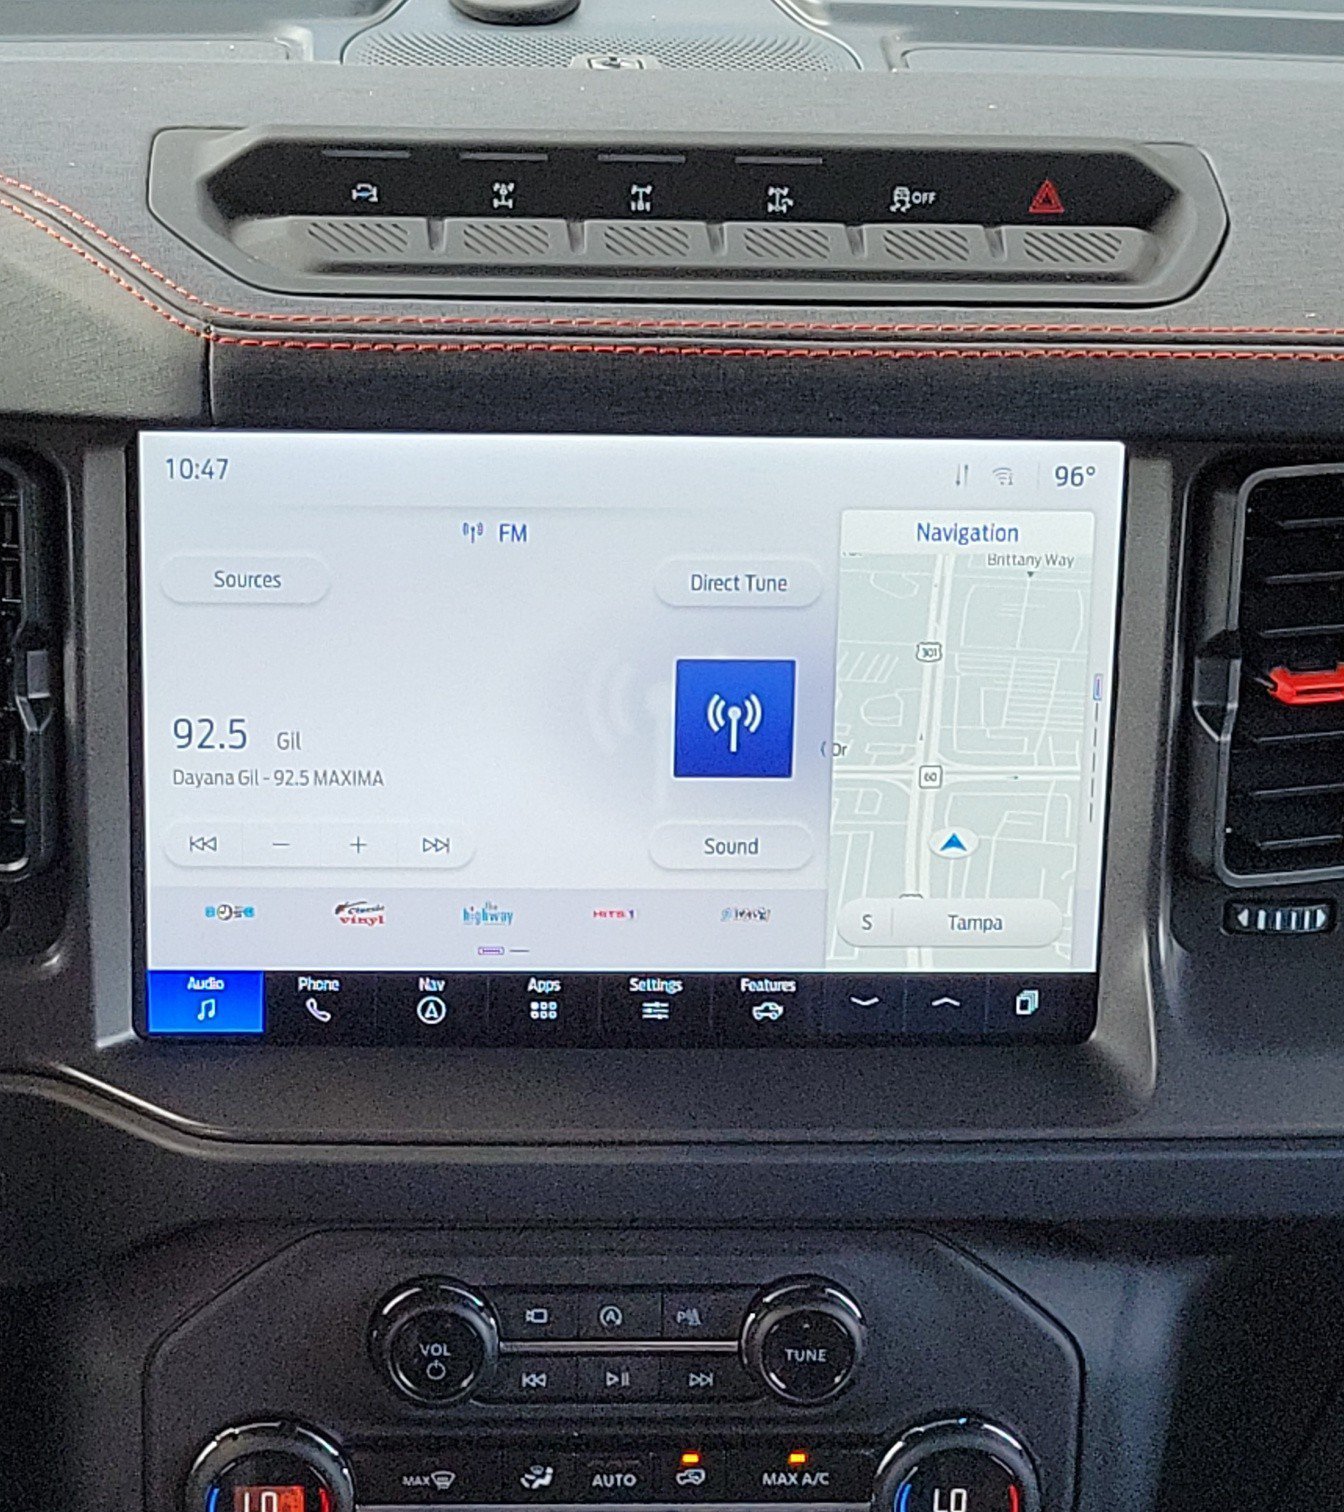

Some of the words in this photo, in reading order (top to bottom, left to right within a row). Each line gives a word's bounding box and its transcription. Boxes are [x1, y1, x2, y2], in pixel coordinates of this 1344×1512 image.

[912, 191, 936, 205] OFF
[165, 457, 230, 480] 10:47
[1055, 465, 1097, 487] 96°
[499, 523, 529, 544] FM
[916, 522, 1019, 546] Navigation
[987, 553, 1041, 568] Brittany
[1045, 553, 1074, 568] Way
[213, 569, 282, 590] Sources
[690, 573, 741, 592] Direct
[746, 573, 788, 592] Tune
[172, 718, 248, 752] 92.5
[276, 731, 302, 752] Gil
[172, 768, 235, 788] Dayana
[237, 768, 260, 787] Gil
[273, 769, 310, 787] 92.5
[313, 769, 385, 787] MAXIMA
[704, 837, 759, 856] Sound
[861, 914, 873, 932] S
[948, 914, 1003, 935] Tampa
[186, 976, 225, 992] Audio
[297, 976, 341, 992] Phone
[418, 977, 446, 992] Nav
[527, 978, 562, 995] Apps
[628, 977, 683, 995] Settings
[740, 978, 797, 993] Features
[418, 1343, 452, 1358] VOL
[784, 1348, 828, 1362] TUNE
[402, 1475, 430, 1487] MAX
[591, 1473, 637, 1488] AUTO
[762, 1472, 801, 1486] MAX
[802, 1472, 830, 1487] A/C
